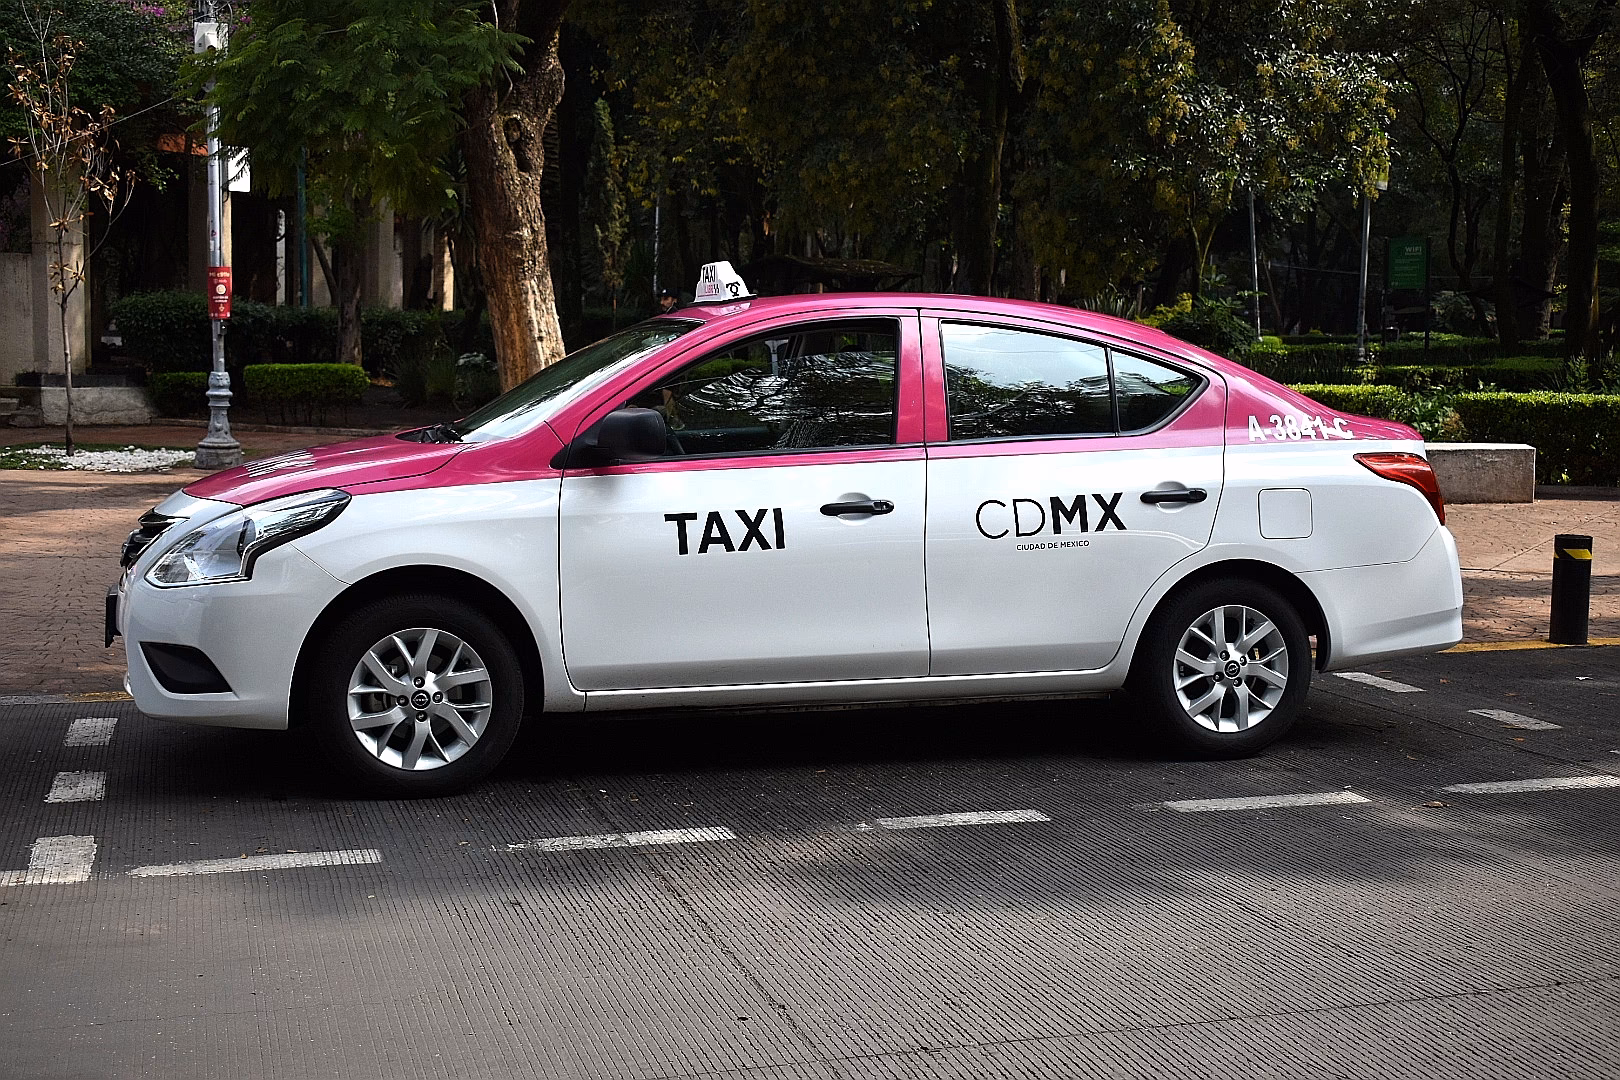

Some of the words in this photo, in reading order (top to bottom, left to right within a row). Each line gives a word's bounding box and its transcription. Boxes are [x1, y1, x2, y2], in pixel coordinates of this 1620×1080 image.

[702, 265, 716, 283] TAXI
[1248, 414, 1354, 441] A-3841-C
[975, 492, 1127, 539] CDMX
[664, 508, 786, 555] TAXI
[1016, 543, 1046, 551] CIUDAD
[1060, 540, 1090, 548] MEXICO
